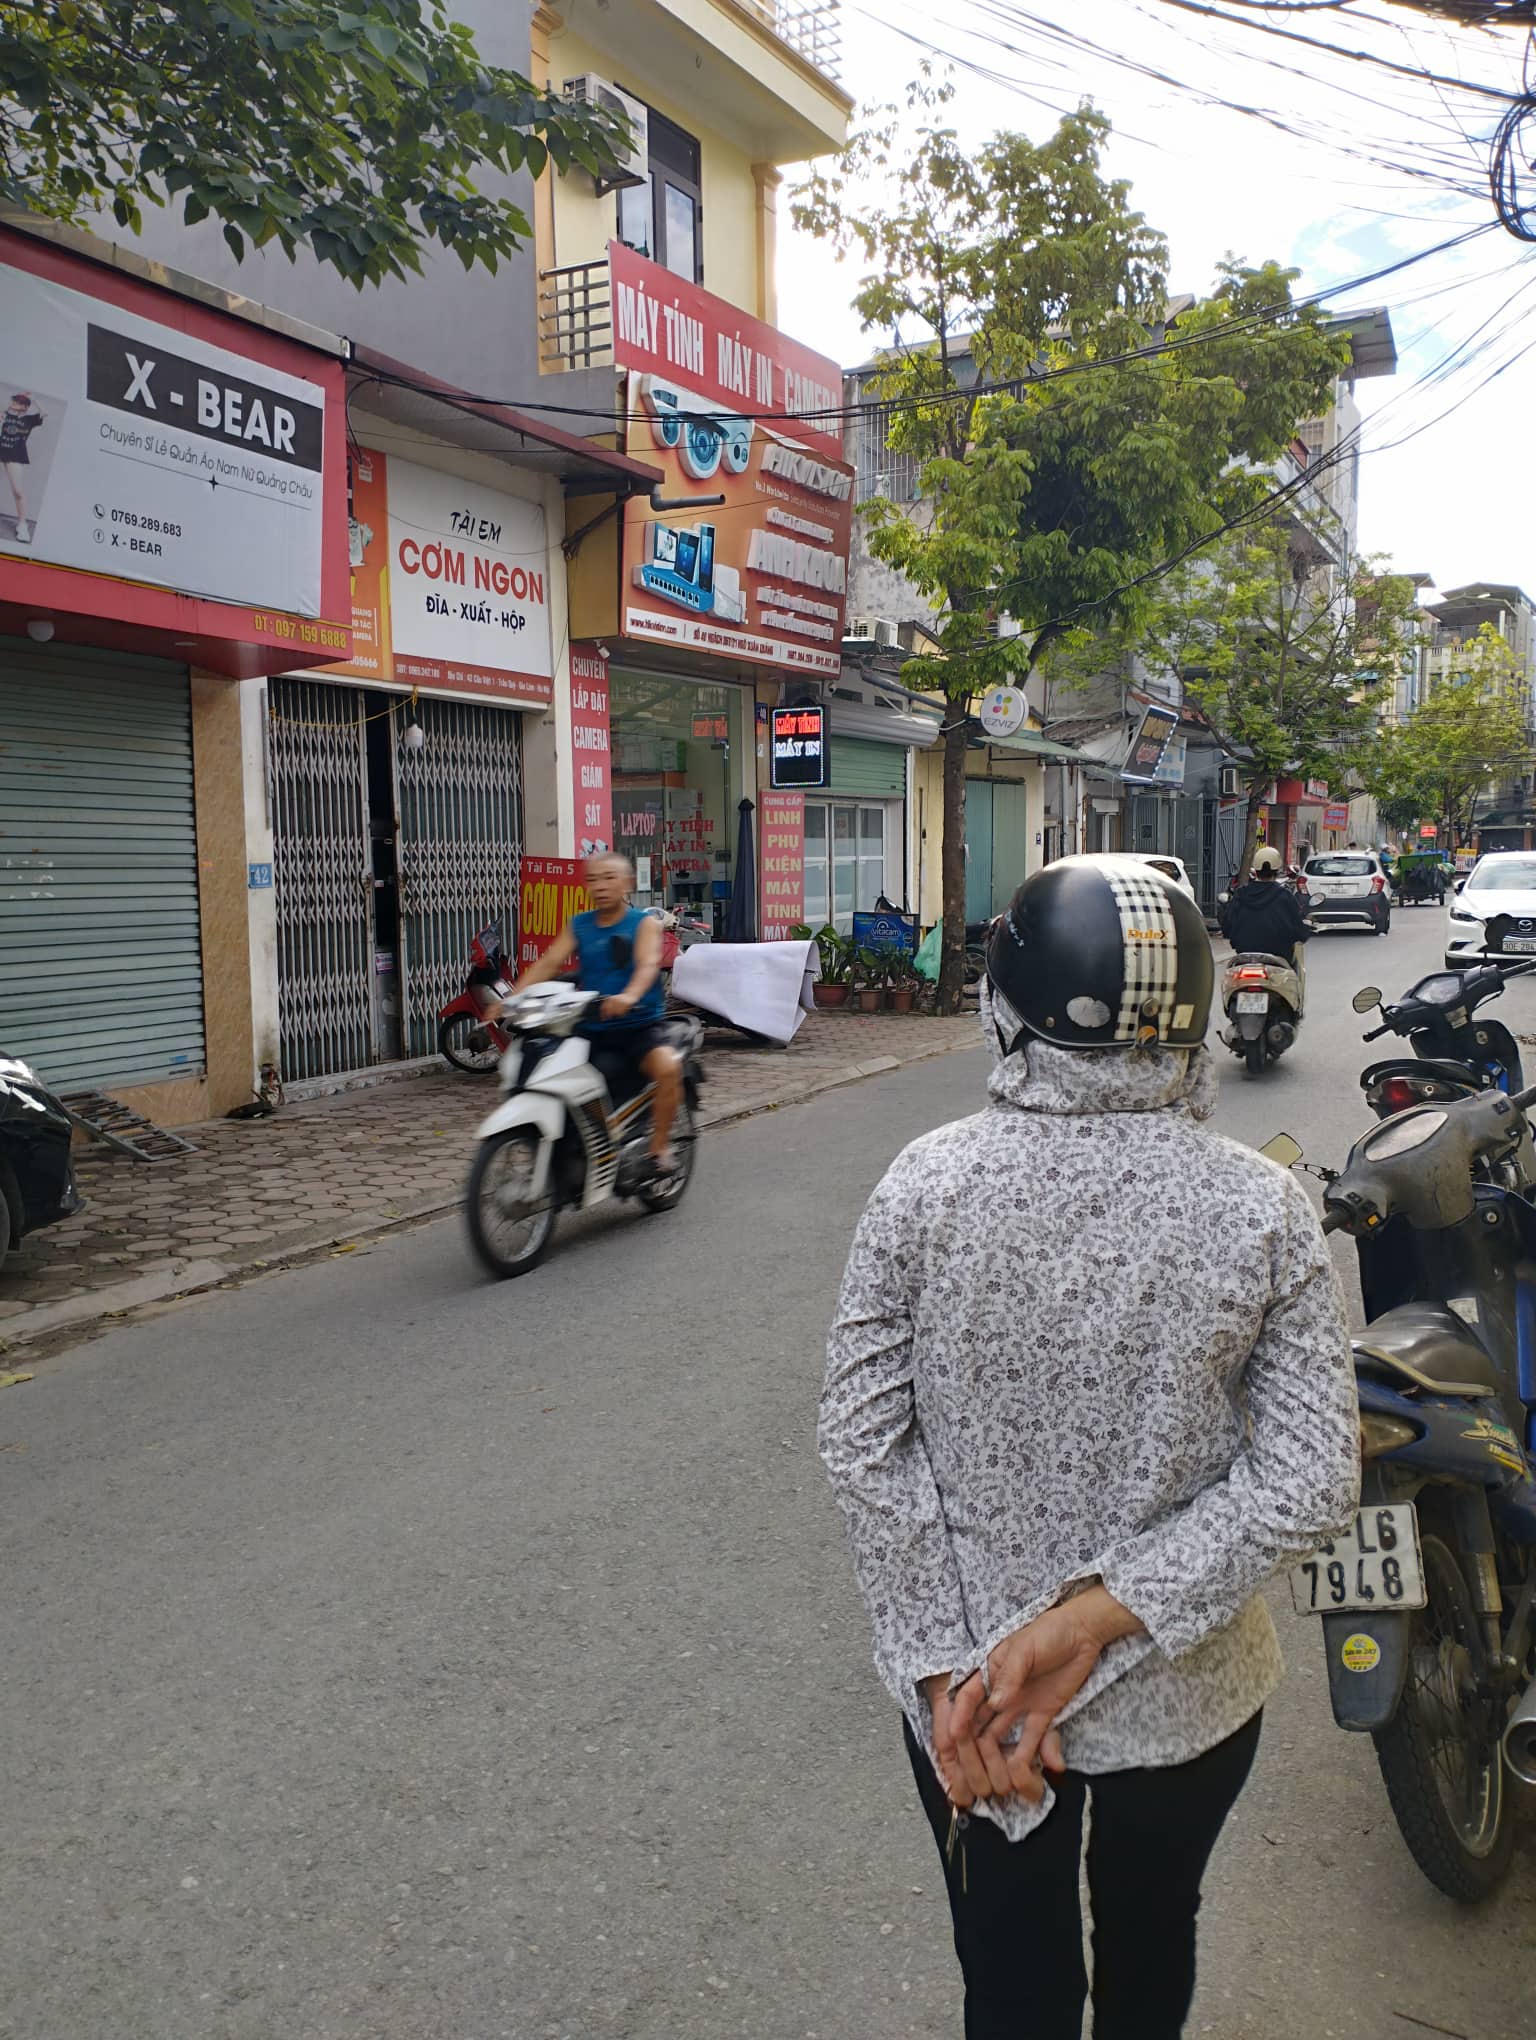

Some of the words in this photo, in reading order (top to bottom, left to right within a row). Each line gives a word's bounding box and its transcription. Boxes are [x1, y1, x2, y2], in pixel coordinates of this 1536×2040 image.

[617, 280, 659, 355] MÁY
[663, 298, 704, 377] TÍNH
[717, 330, 753, 399] MÁY
[756, 352, 773, 408] IN
[784, 367, 839, 440] CAMERA
[123, 352, 157, 409] X
[198, 379, 296, 454] BEAR
[99, 423, 143, 449] Chuyên
[216, 458, 239, 478] Nam
[110, 509, 182, 537] 0769.289.683
[450, 509, 475, 536] TÀI
[479, 519, 502, 544] EM
[111, 534, 119, 547] X
[130, 538, 162, 557] BEAR
[399, 538, 465, 586] CƠM
[474, 556, 543, 605] NGON
[426, 594, 449, 617] ĐĨA
[460, 600, 492, 625] XUẤT
[501, 610, 526, 634] HỘP
[275, 620, 296, 638] 097
[299, 624, 318, 643] 159
[320, 629, 347, 649] 6888
[573, 656, 606, 680] CHUYÊN
[573, 683, 589, 710] LẮP
[776, 713, 797, 735] MÁY
[798, 712, 820, 733] TÍNH
[984, 718, 1016, 729] EZVIZ
[574, 726, 608, 750] CAMERA
[776, 737, 803, 758] MÁY
[805, 740, 820, 756] IN
[581, 762, 603, 788] GIÁM
[585, 800, 601, 827] SÁT
[620, 812, 656, 836] LAPTOP
[765, 811, 800, 825] LINH
[768, 834, 799, 851] PHỤ
[527, 861, 542, 873] Tài
[546, 863, 562, 875] Em
[567, 864, 575, 875] 5
[765, 855, 801, 875] KIỆN
[766, 879, 800, 895] MÁY
[522, 878, 558, 937] CƠM
[766, 902, 800, 918] TÍNH
[764, 923, 789, 941] MÁY
[523, 940, 538, 962] ĐĨA
[1302, 1557, 1404, 1608] 7948
